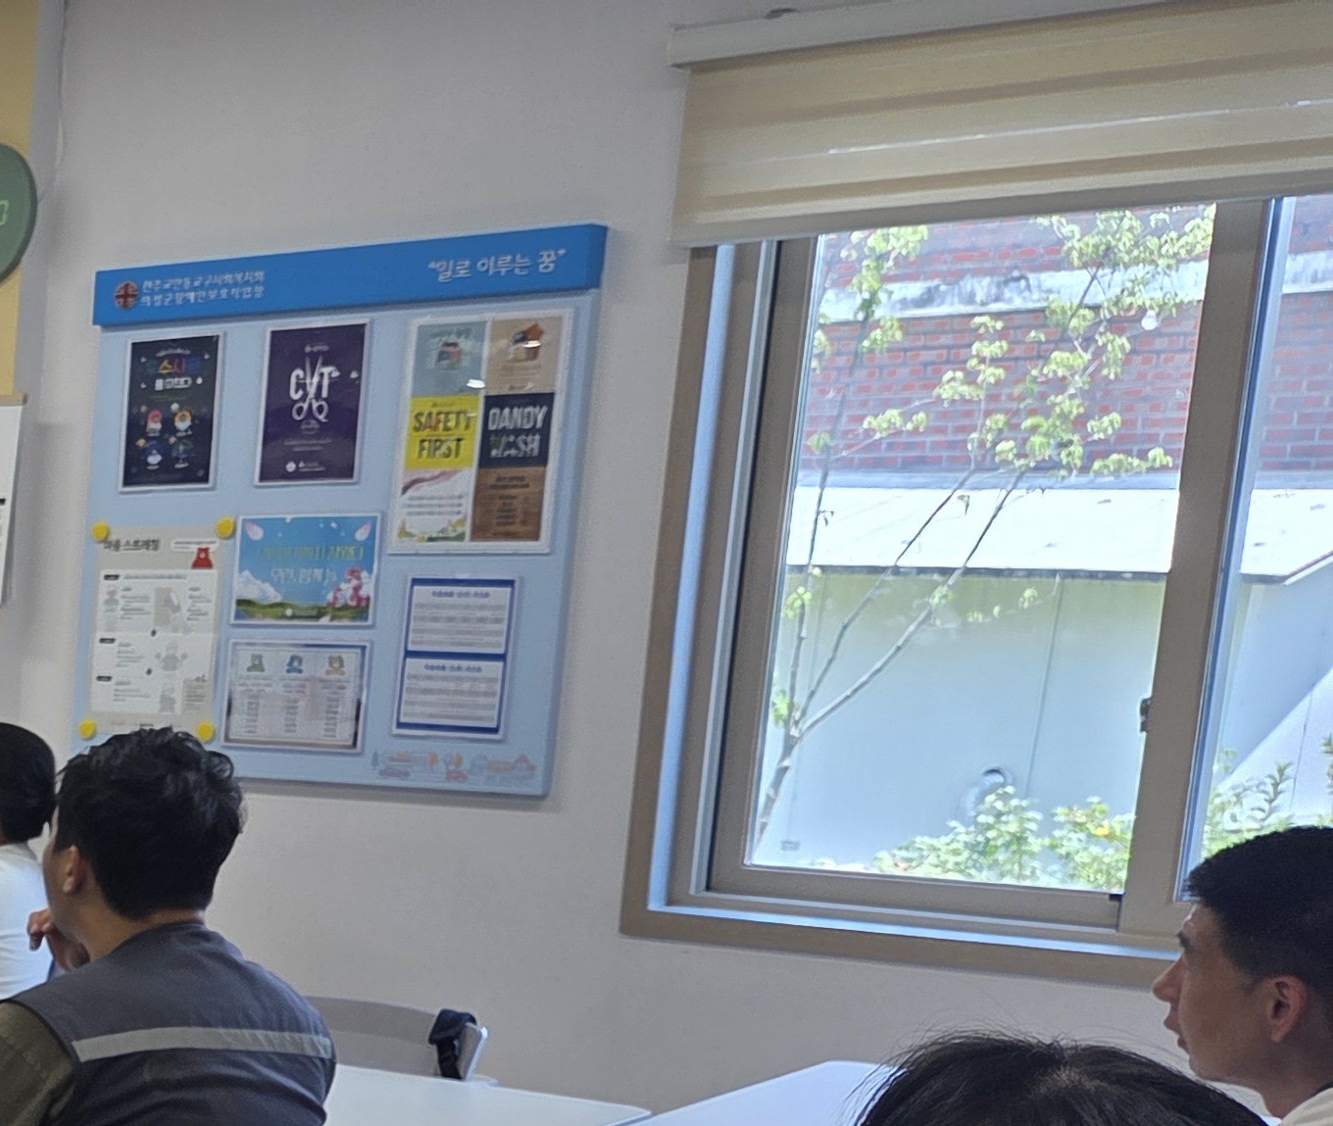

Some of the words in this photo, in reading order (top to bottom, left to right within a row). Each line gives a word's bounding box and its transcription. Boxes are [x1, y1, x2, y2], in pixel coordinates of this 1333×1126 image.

[477, 253, 532, 276] 이루는
[413, 409, 476, 432] SAFETY
[488, 405, 548, 431] DANDY
[418, 437, 465, 459] FIRST
